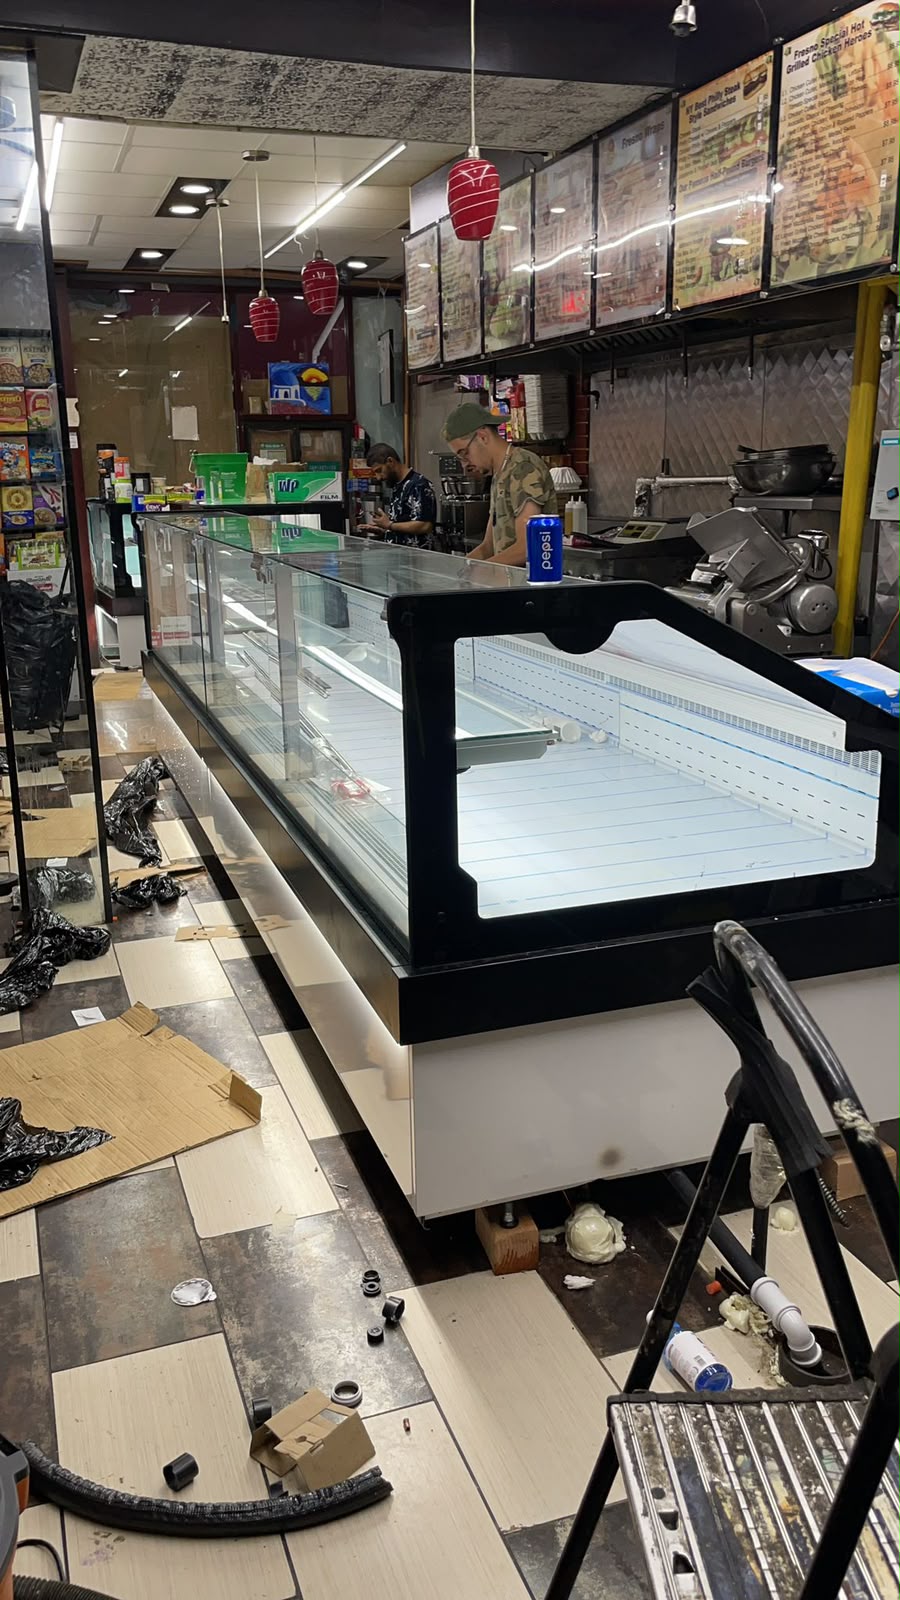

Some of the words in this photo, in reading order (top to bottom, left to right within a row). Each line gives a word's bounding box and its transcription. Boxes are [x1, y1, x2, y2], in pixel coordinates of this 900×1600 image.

[786, 57, 810, 74] Grilled
[811, 44, 842, 63] Chicken
[844, 30, 872, 47] Heroes
[794, 43, 819, 60] Fresno
[820, 27, 849, 47] Special
[850, 20, 865, 34] Hot
[703, 95, 736, 117] Sandwiches
[724, 82, 741, 96] Steak
[539, 531, 554, 570] pepsi
